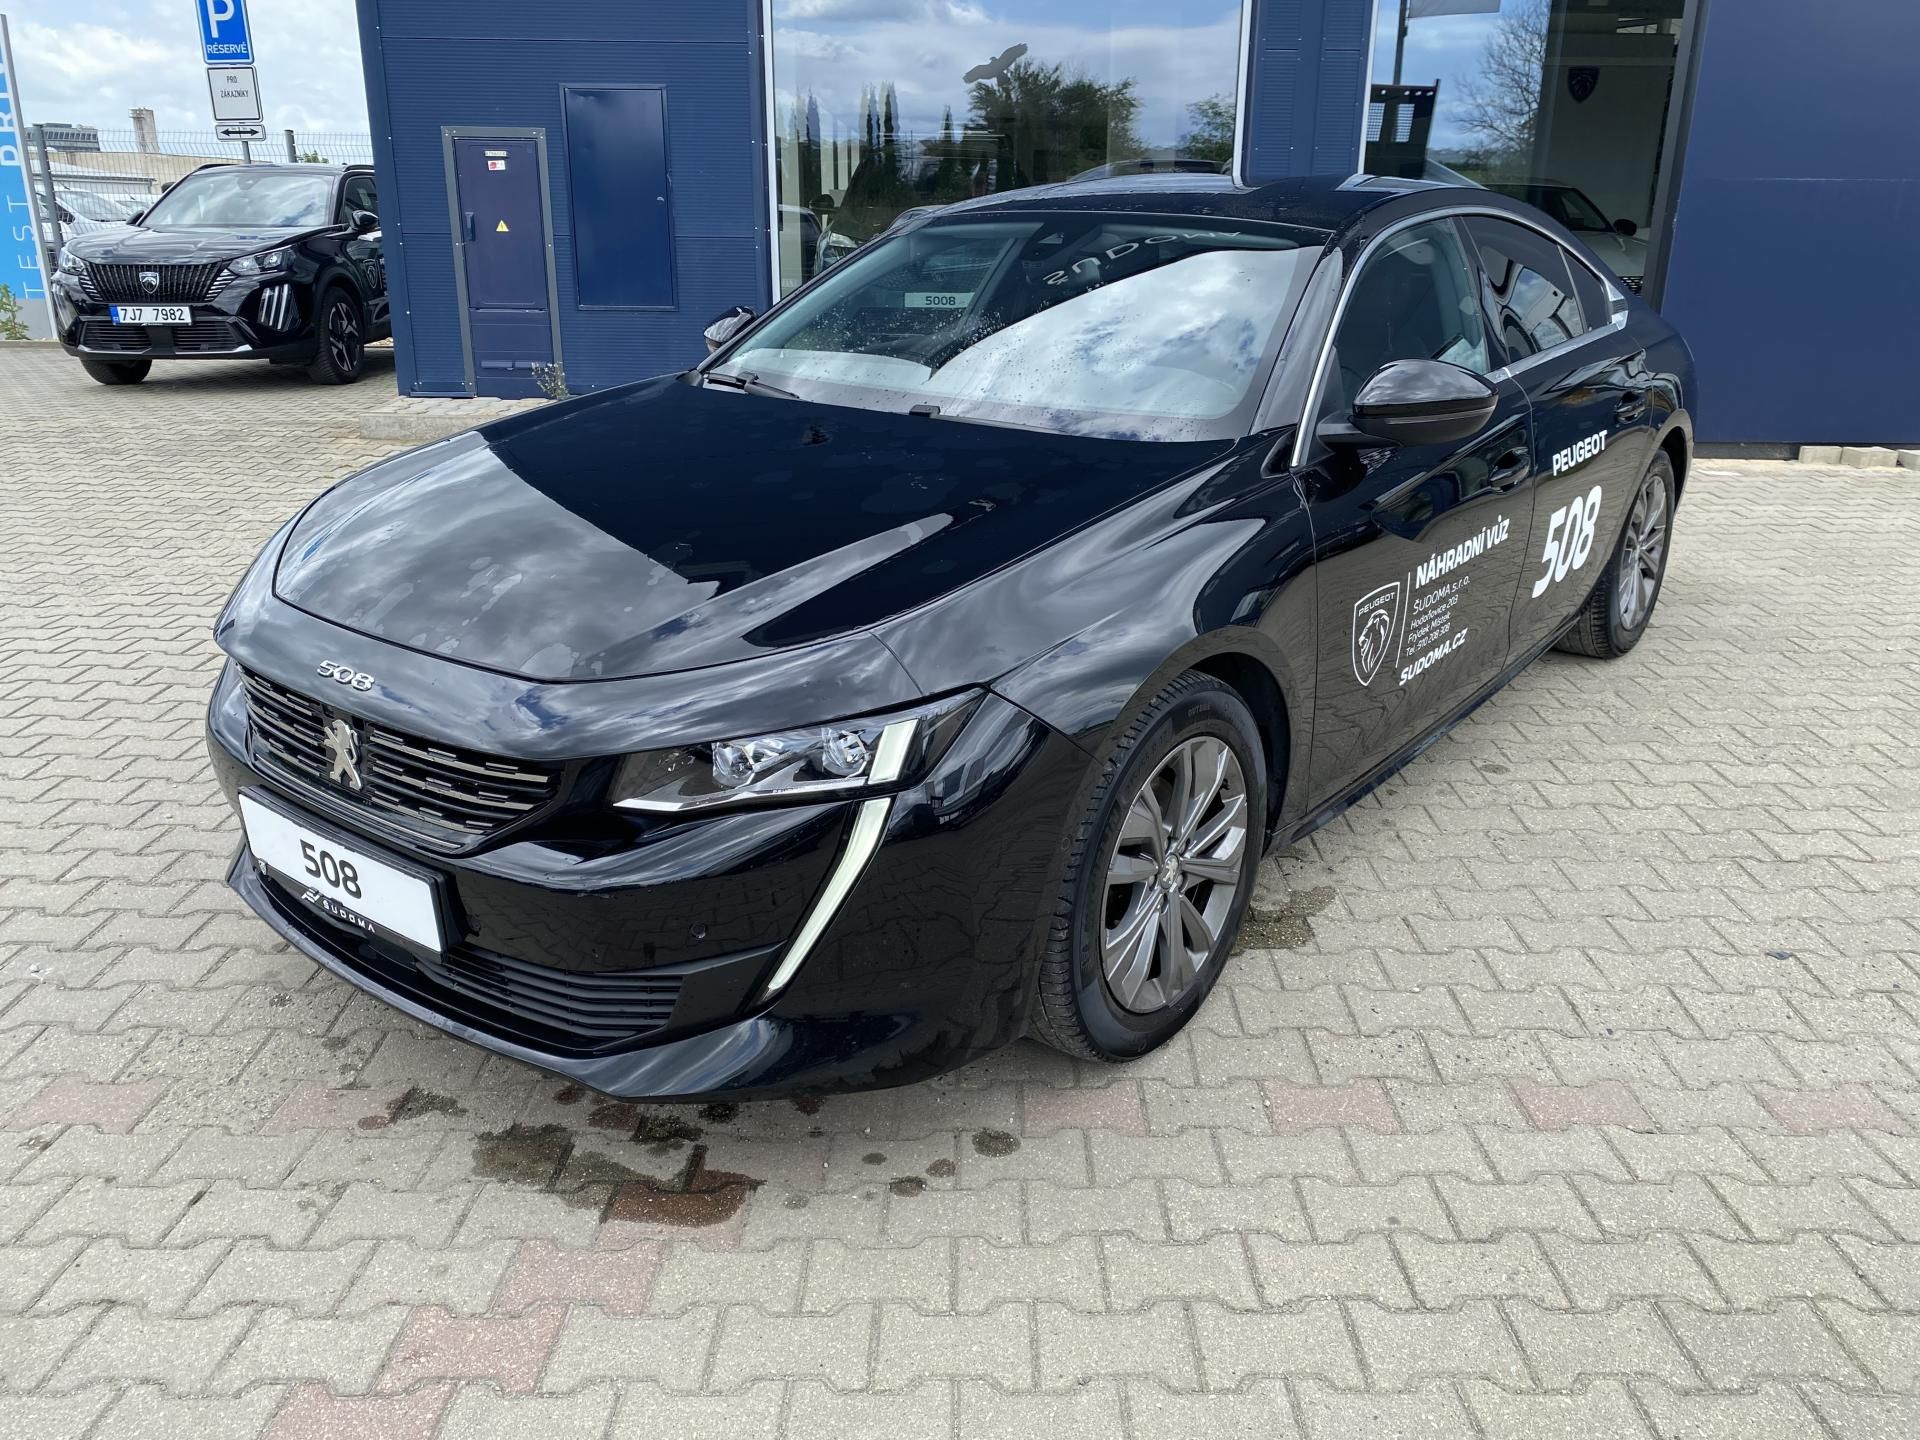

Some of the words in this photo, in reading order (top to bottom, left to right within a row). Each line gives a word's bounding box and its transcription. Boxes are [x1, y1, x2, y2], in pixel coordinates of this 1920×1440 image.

[206, 0, 235, 38] P
[207, 42, 248, 54] RÉSERVÉ
[226, 76, 238, 84] PRO
[7, 194, 46, 299] TEST
[120, 308, 143, 321] 7J7
[152, 308, 185, 321] 7982
[925, 296, 956, 306] 5008
[1552, 430, 1608, 477] PEUGEOT
[1415, 526, 1487, 589] NÁHRADNÍ
[1486, 514, 1510, 549] VŮZ
[1532, 485, 1602, 598] 508
[1358, 592, 1395, 617] PEUGEOT
[1412, 584, 1451, 615] ŠUDOMA
[1451, 575, 1471, 592] s.r.o.
[317, 660, 374, 691] 508
[1399, 627, 1468, 686] SUDOMA.CZ
[300, 838, 361, 899] 508
